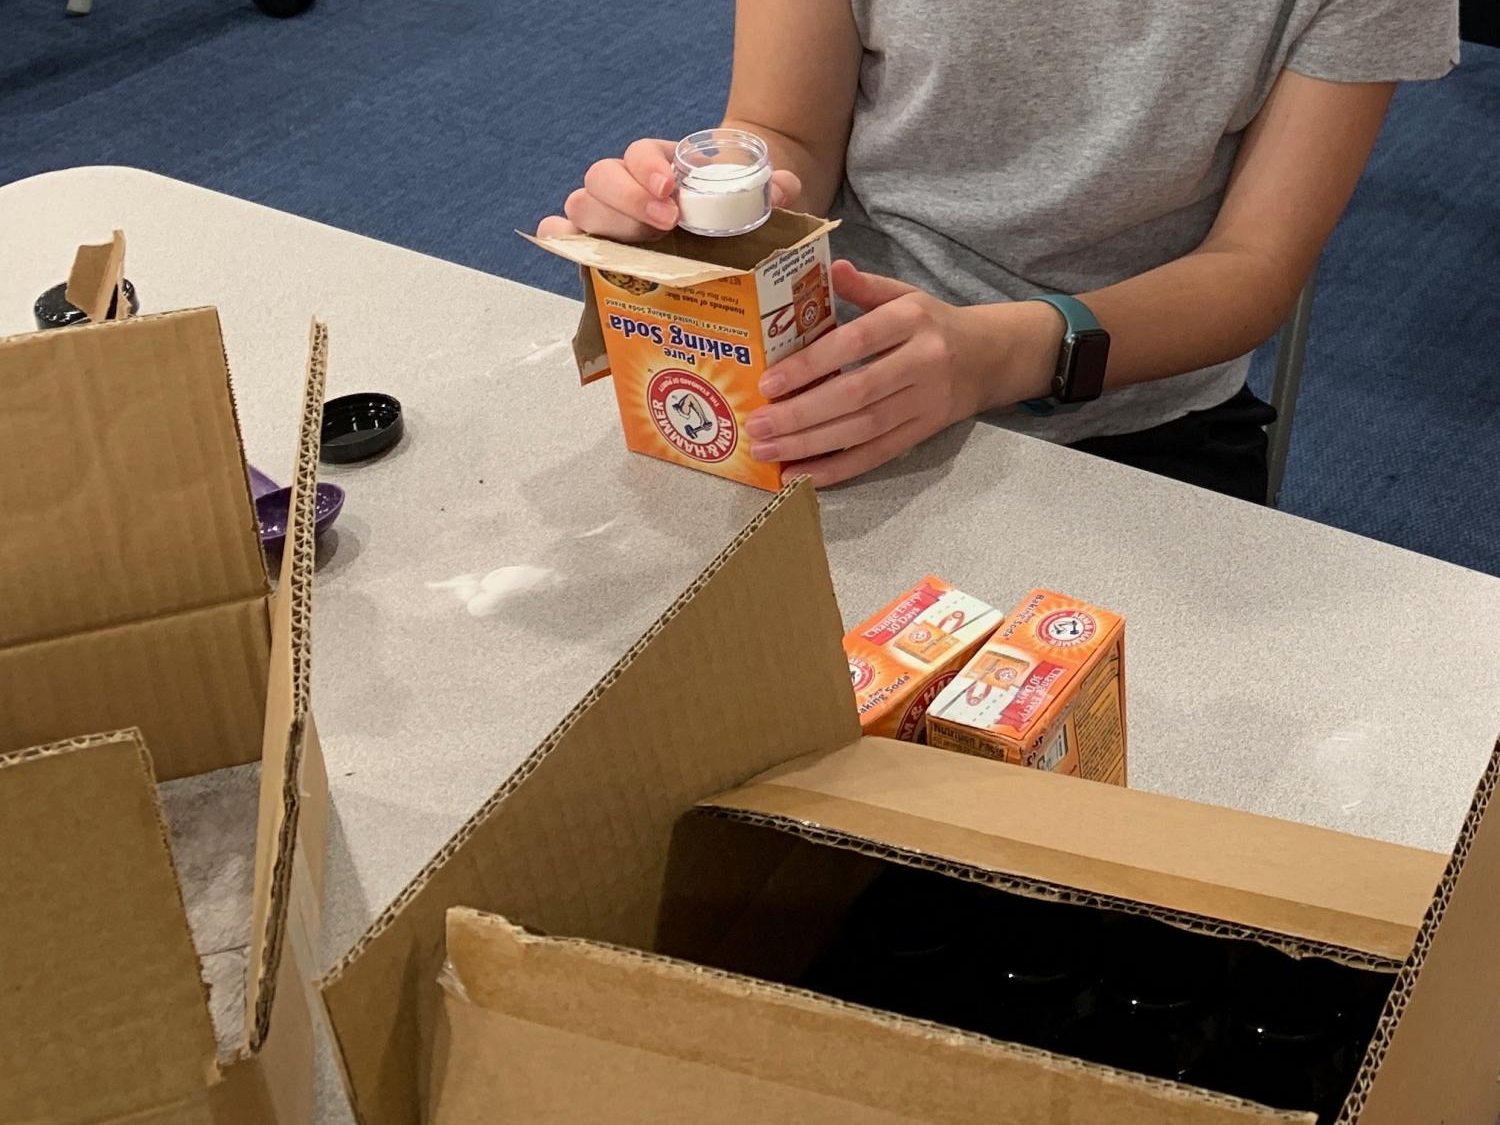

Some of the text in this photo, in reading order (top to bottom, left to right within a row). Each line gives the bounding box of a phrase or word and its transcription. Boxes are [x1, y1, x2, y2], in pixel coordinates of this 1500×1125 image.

[604, 298, 628, 309] Brand
[628, 304, 646, 314] Soda
[681, 295, 699, 305] uses
[709, 300, 745, 315] Hundreds
[646, 307, 672, 321] Baking
[673, 315, 701, 327] Trusted
[609, 314, 751, 365] Baking Soda
[664, 347, 696, 365] Pure
[652, 399, 733, 458] ARM & HAMMER
[865, 591, 923, 638] Change Every
[900, 607, 922, 625] Days
[1017, 594, 1046, 622] Baking
[858, 692, 889, 716] aking
[885, 674, 911, 694] Soda
